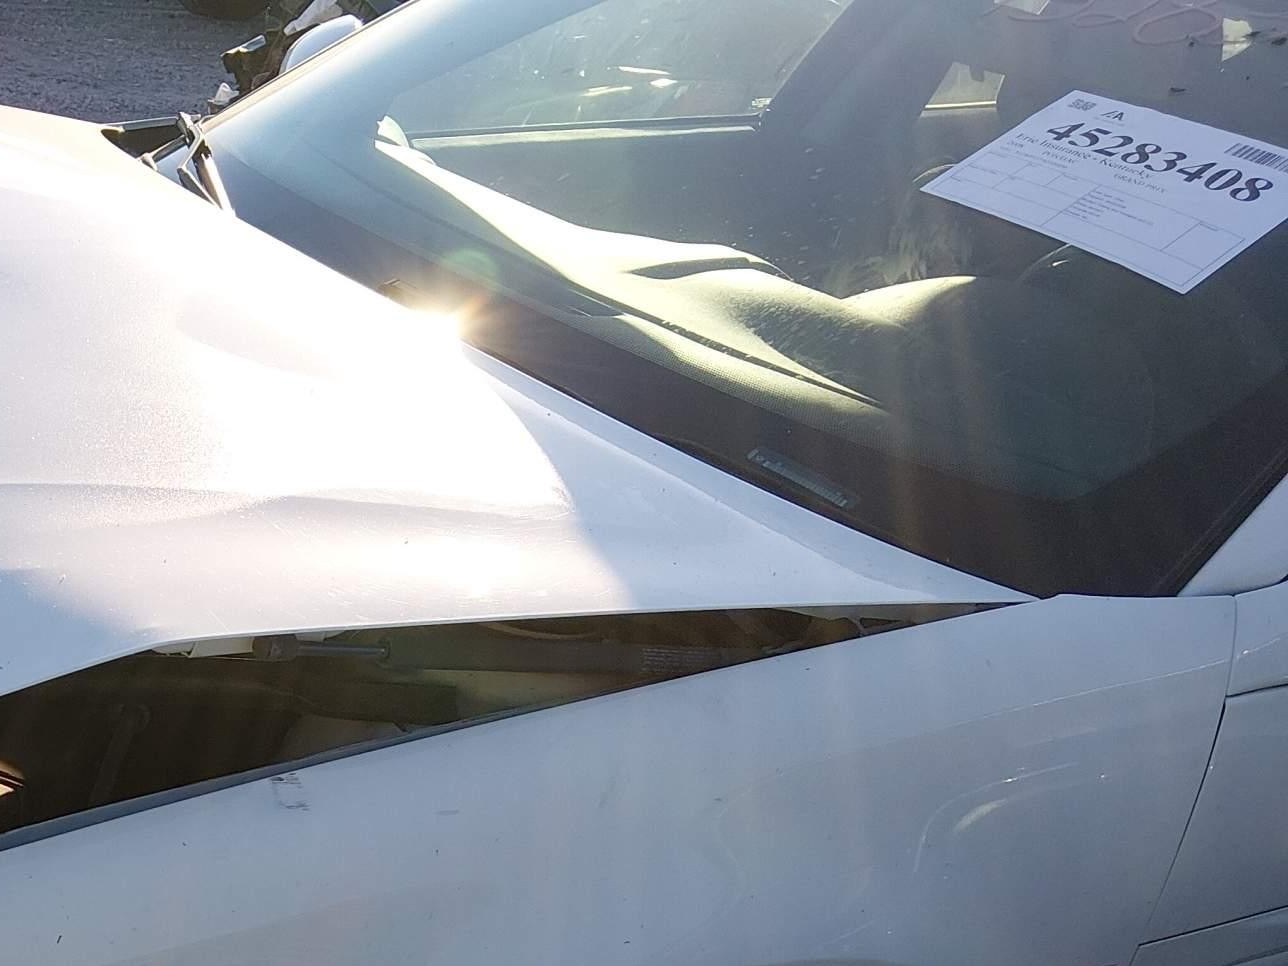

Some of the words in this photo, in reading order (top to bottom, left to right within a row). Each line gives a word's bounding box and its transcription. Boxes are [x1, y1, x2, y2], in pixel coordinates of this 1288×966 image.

[1039, 139, 1092, 160] Insurance
[1099, 157, 1153, 180] Kentucky
[1046, 121, 1274, 202] 45283408
